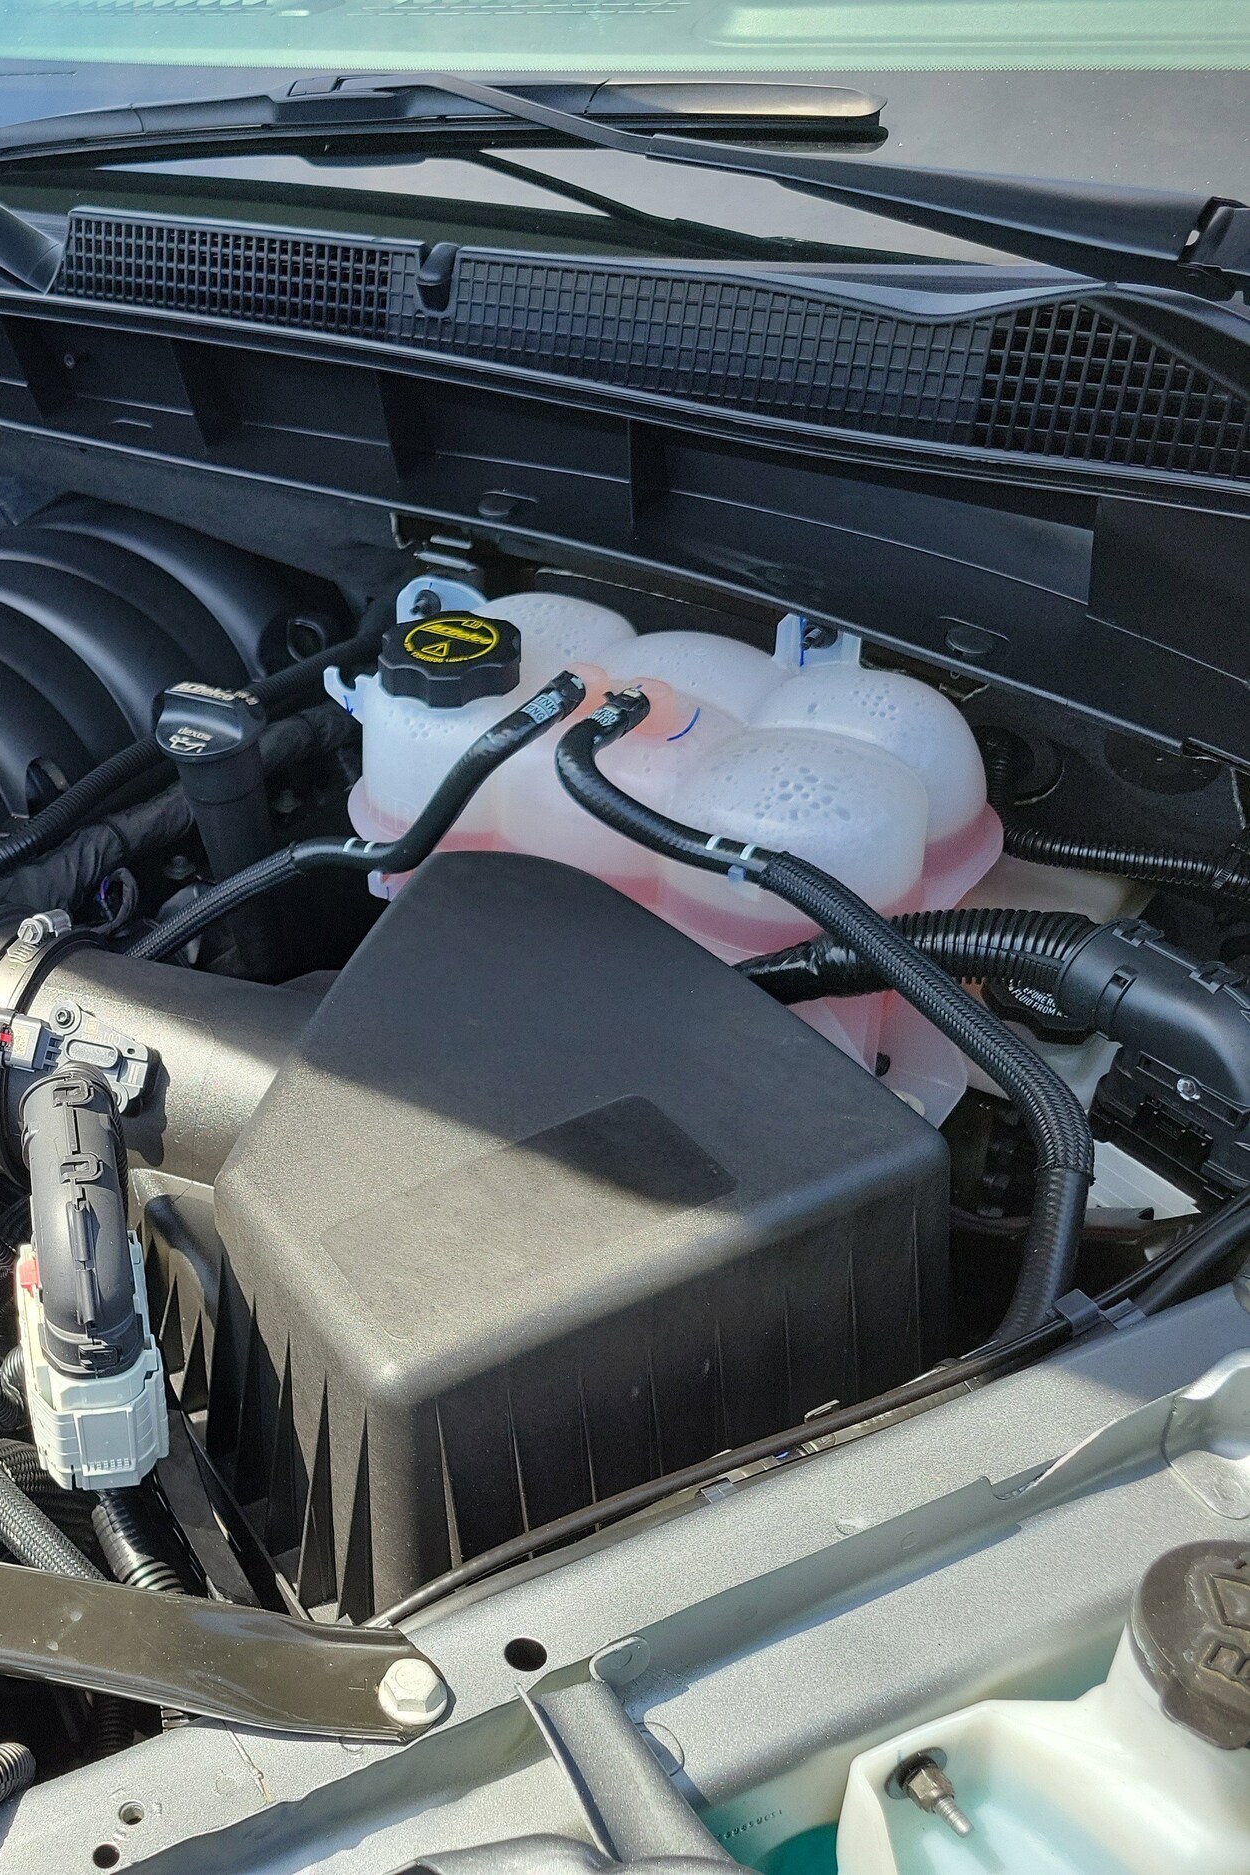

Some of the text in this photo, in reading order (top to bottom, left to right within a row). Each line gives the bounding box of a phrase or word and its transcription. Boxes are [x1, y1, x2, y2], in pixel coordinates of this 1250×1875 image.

[171, 681, 235, 702] ACDelco
[525, 703, 546, 723] ENG
[177, 727, 213, 742] dexos
[1010, 988, 1033, 1007] FLUID
[1031, 1002, 1056, 1017] FROM
